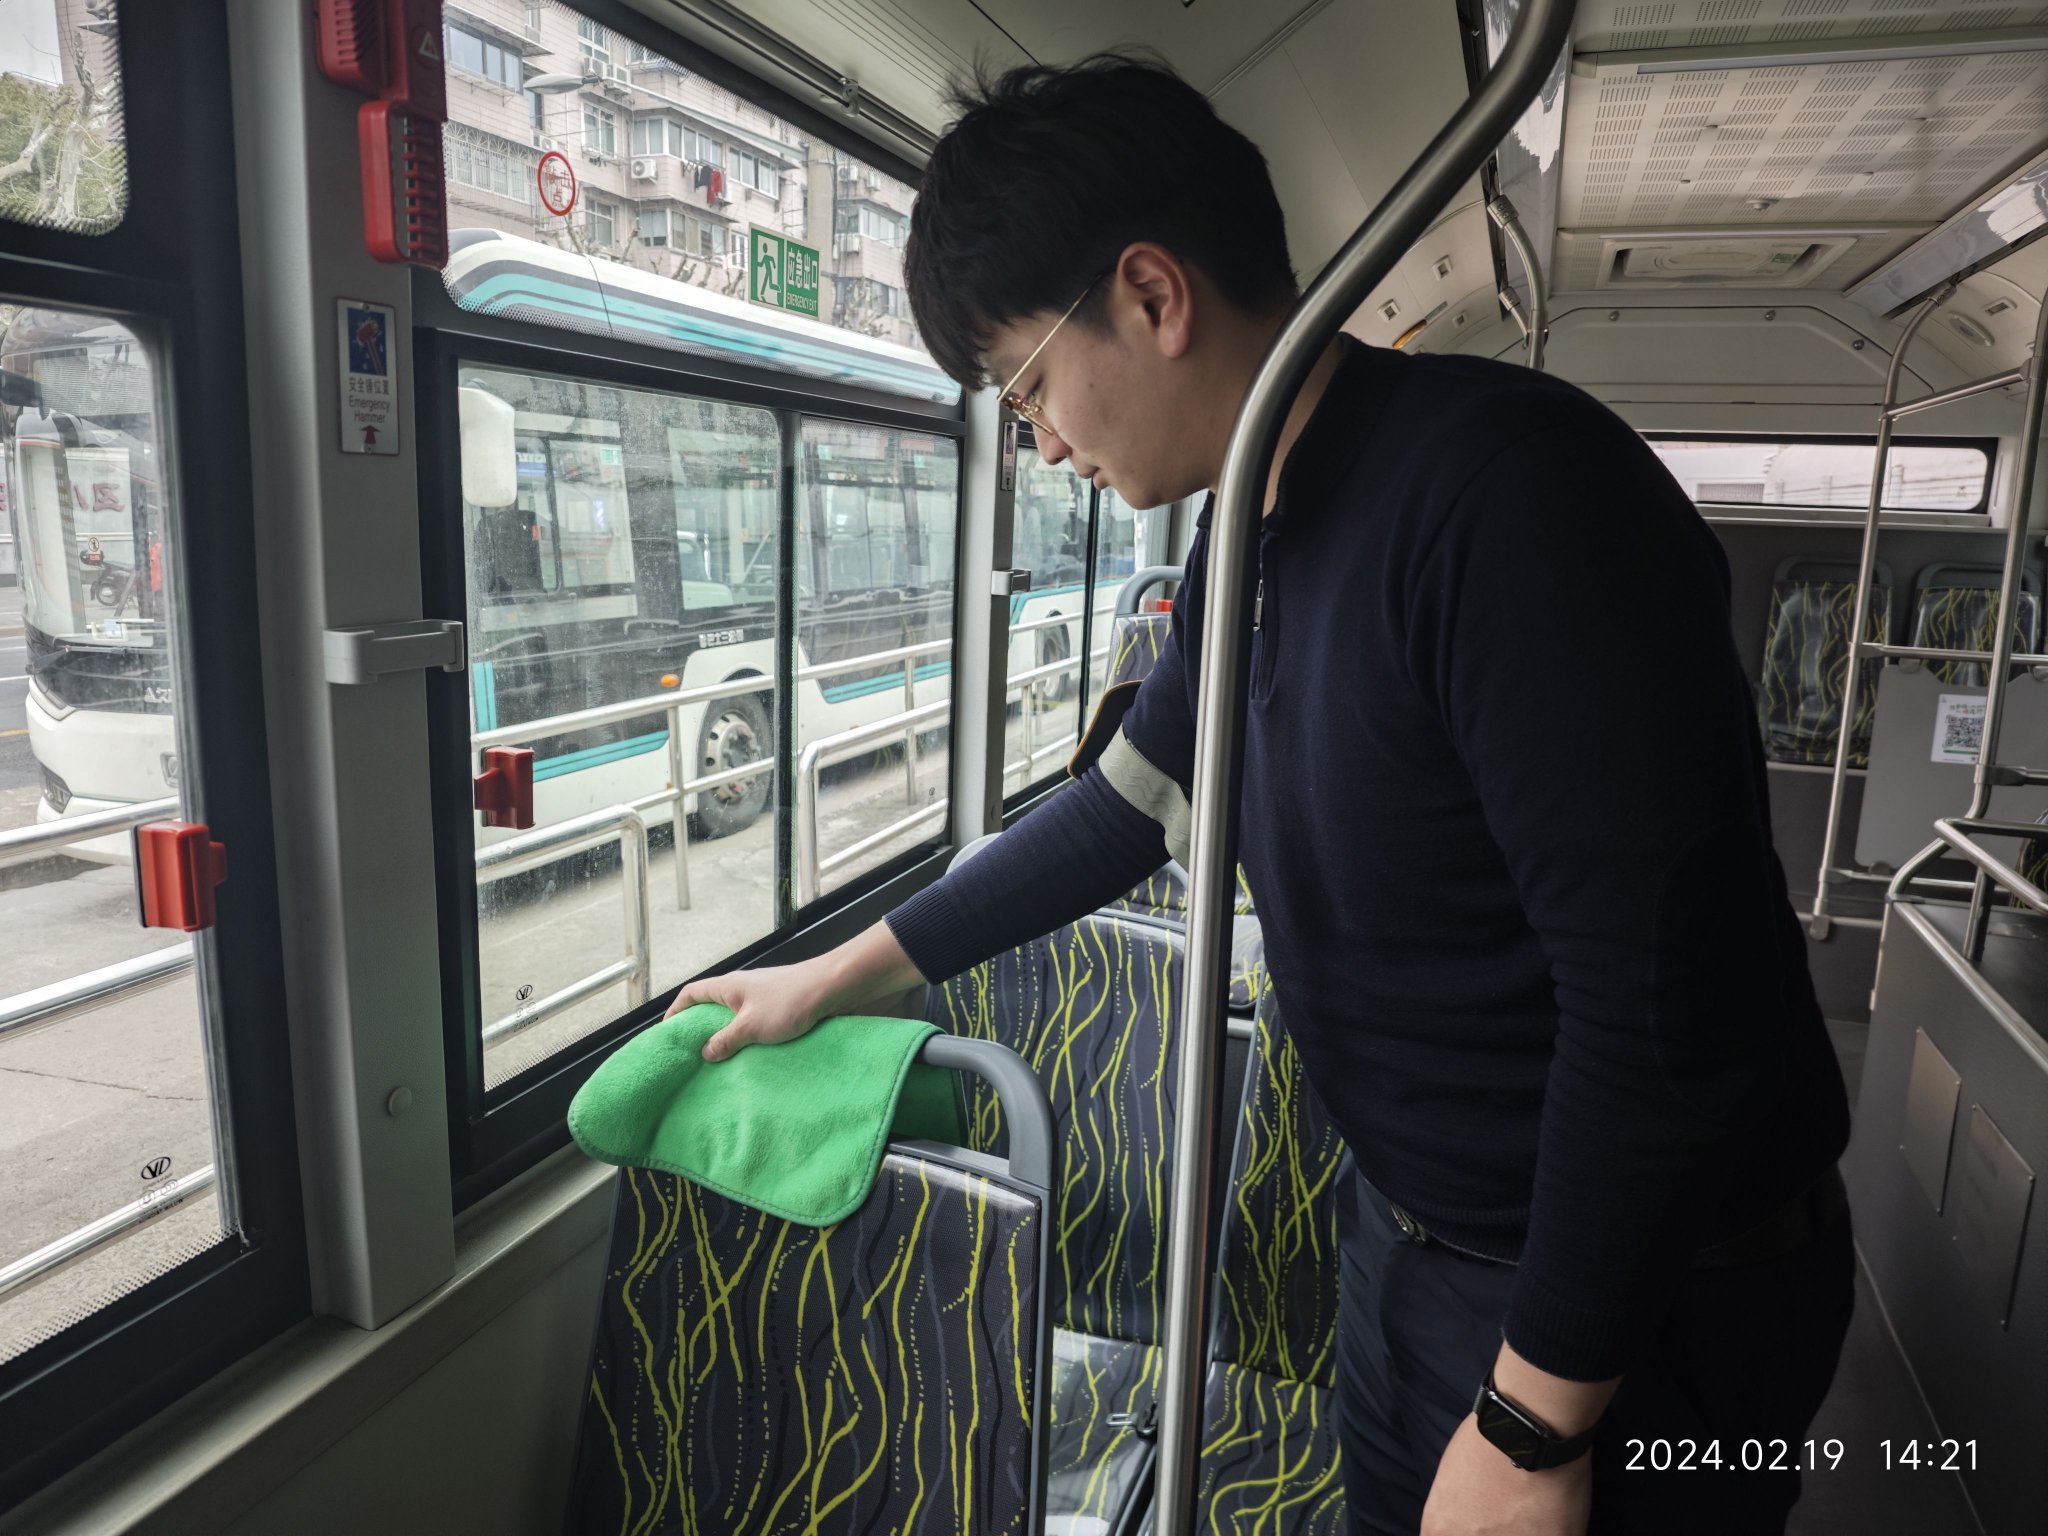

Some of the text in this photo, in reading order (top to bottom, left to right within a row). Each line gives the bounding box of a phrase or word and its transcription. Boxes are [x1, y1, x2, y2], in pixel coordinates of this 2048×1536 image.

[787, 247, 818, 291] 应急出口
[787, 292, 817, 312] EMERGENCY EXIT
[349, 394, 390, 414] Emergency
[354, 409, 386, 424] Hammer
